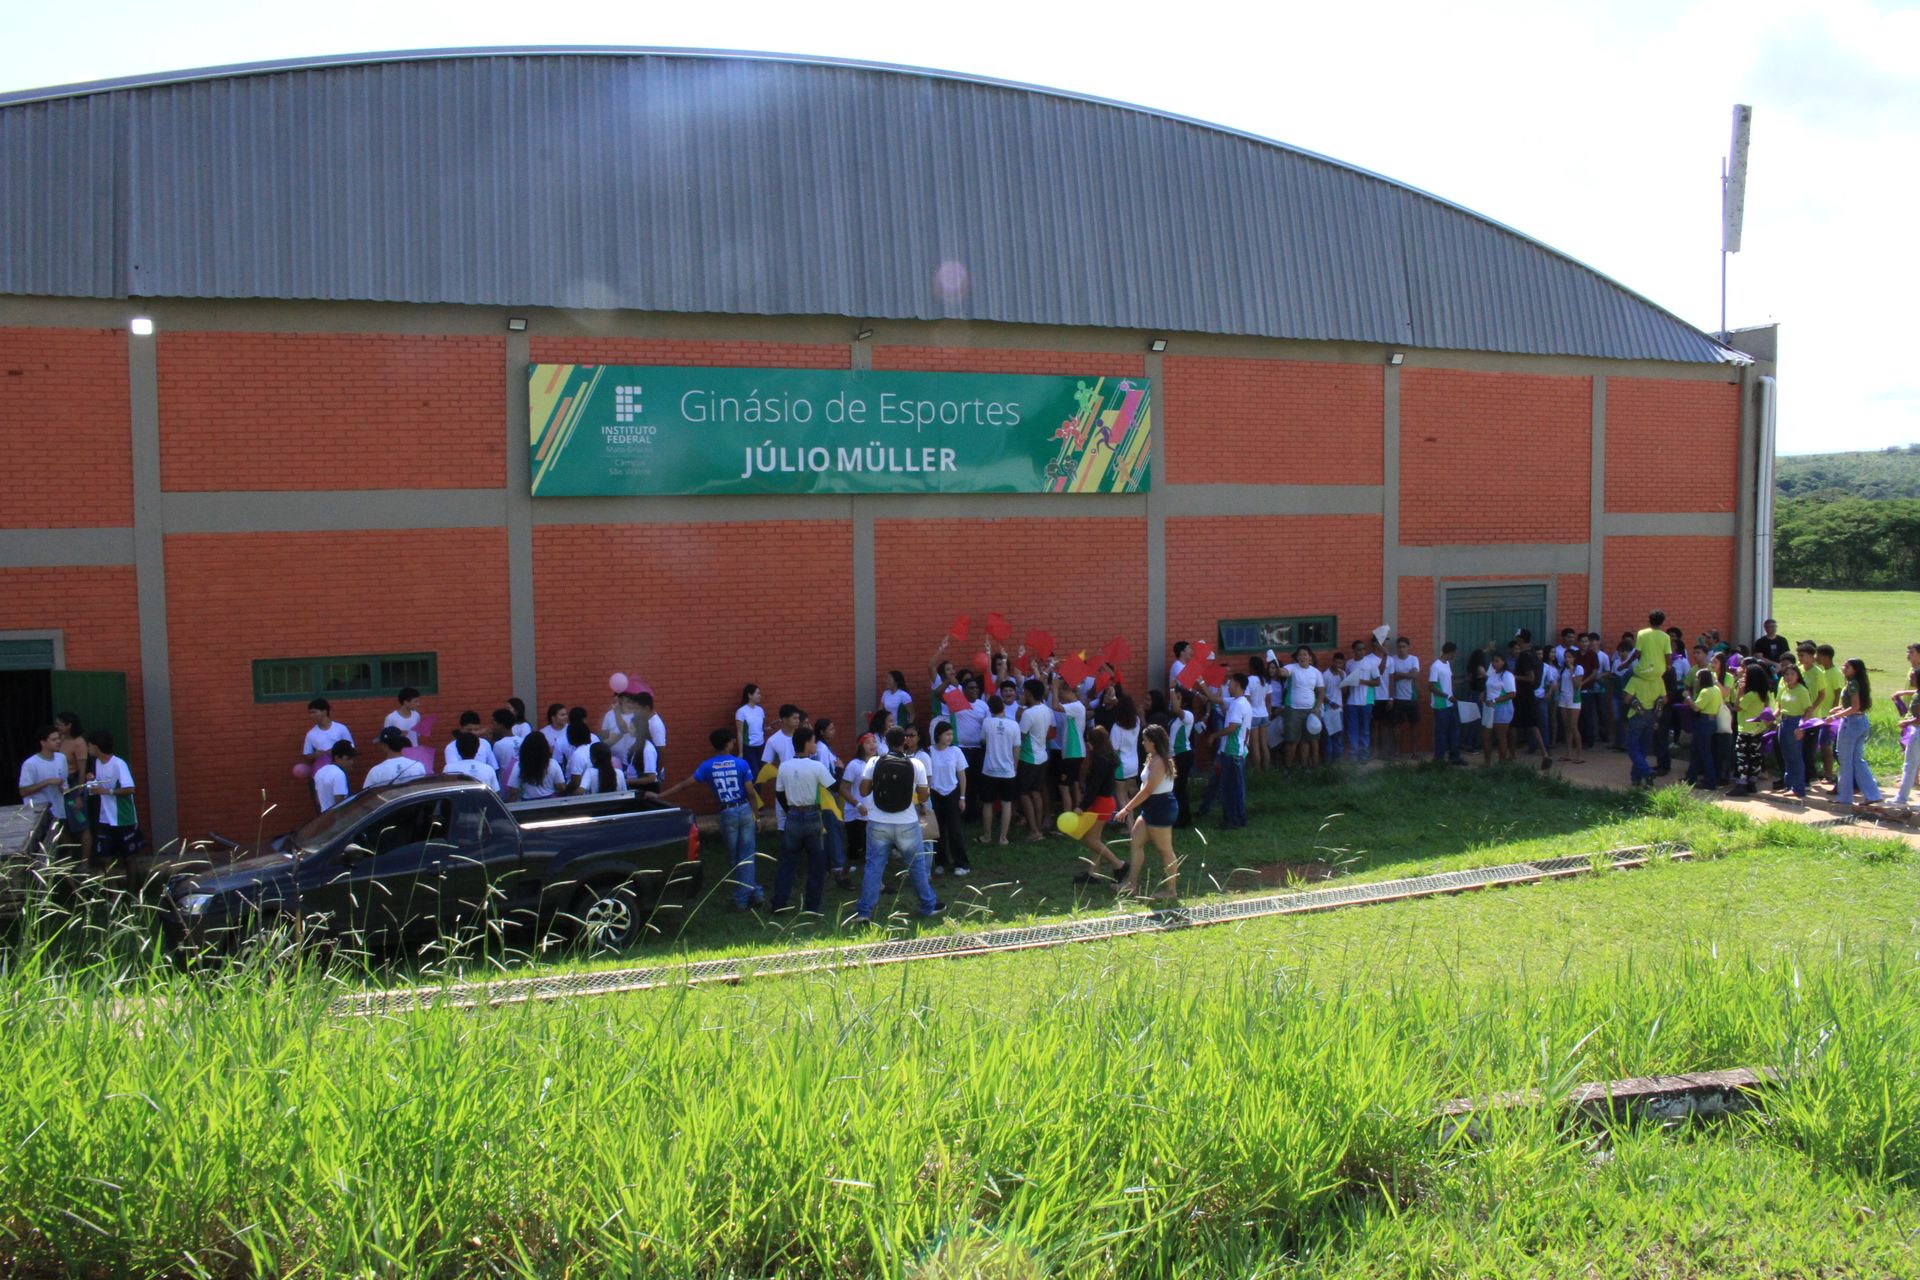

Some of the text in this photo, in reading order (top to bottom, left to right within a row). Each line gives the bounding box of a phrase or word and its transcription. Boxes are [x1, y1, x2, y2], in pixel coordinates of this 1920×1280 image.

[681, 389, 1020, 433] Ginásio de Esportes
[601, 426, 657, 435] INSTITUTO
[607, 435, 652, 444] FEDERAL
[741, 440, 957, 478] JÚLIO MÜLLER
